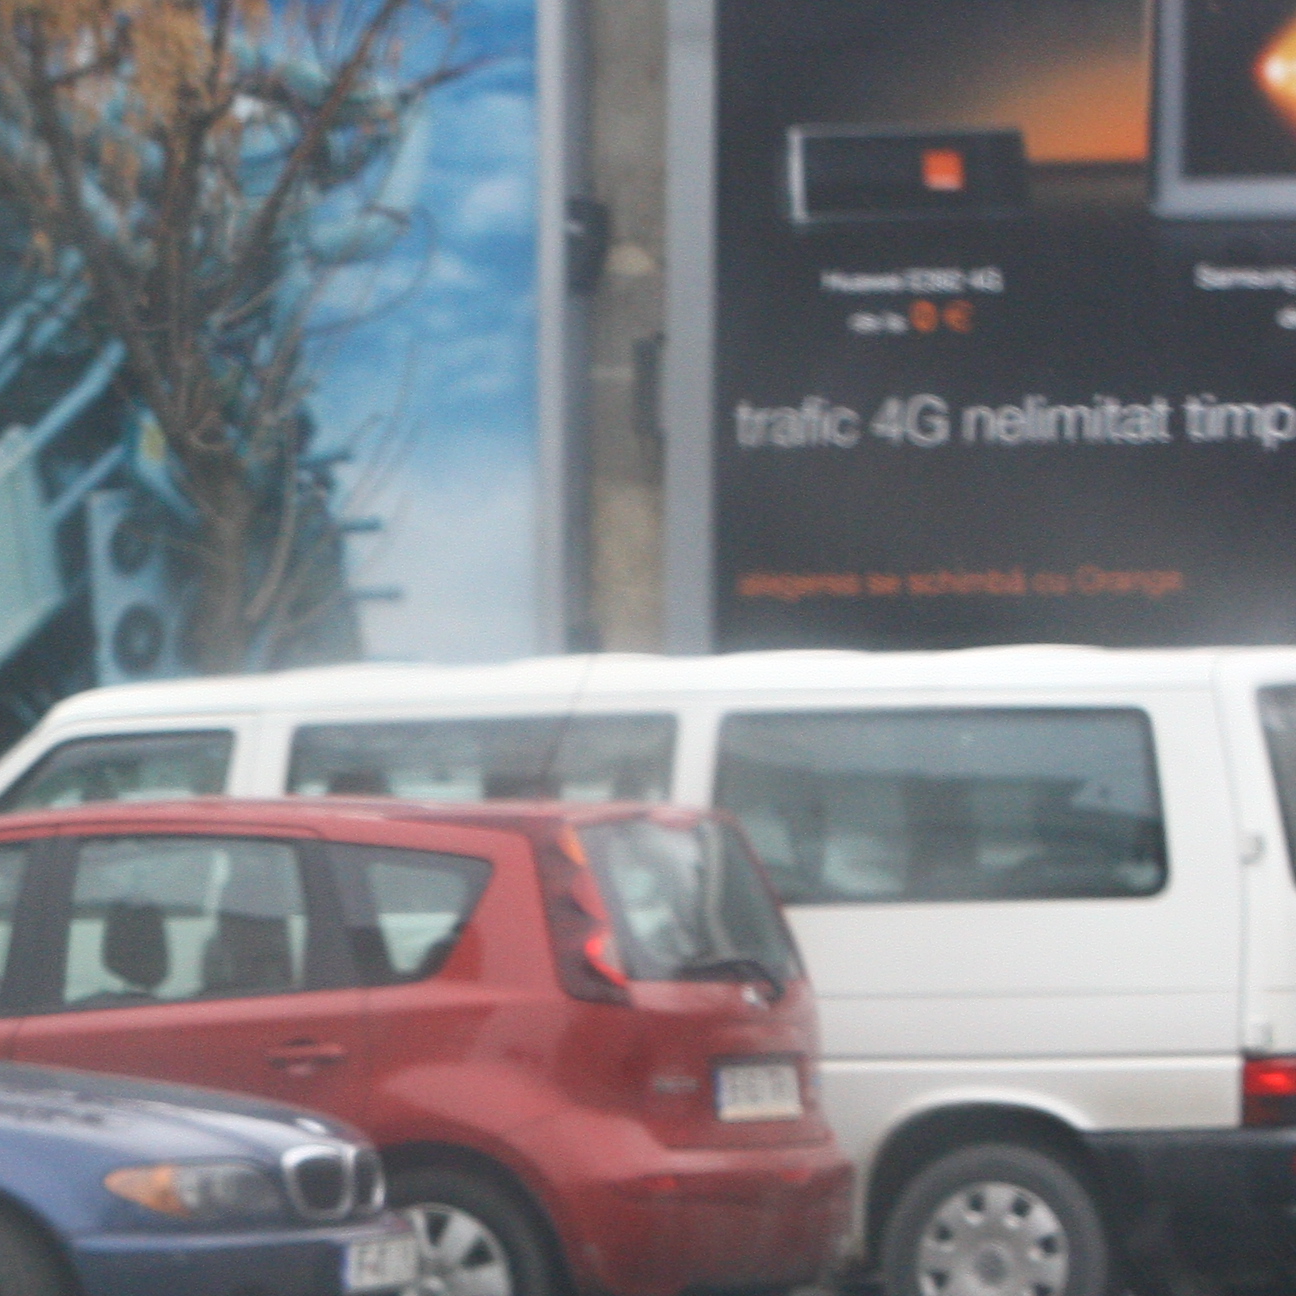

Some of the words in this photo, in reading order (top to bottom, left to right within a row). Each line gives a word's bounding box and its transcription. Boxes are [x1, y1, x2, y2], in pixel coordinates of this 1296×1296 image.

[735, 396, 861, 449] trafic
[870, 393, 951, 449] 4G
[961, 394, 1171, 445] nelimitat
[1184, 392, 1296, 451] timp
